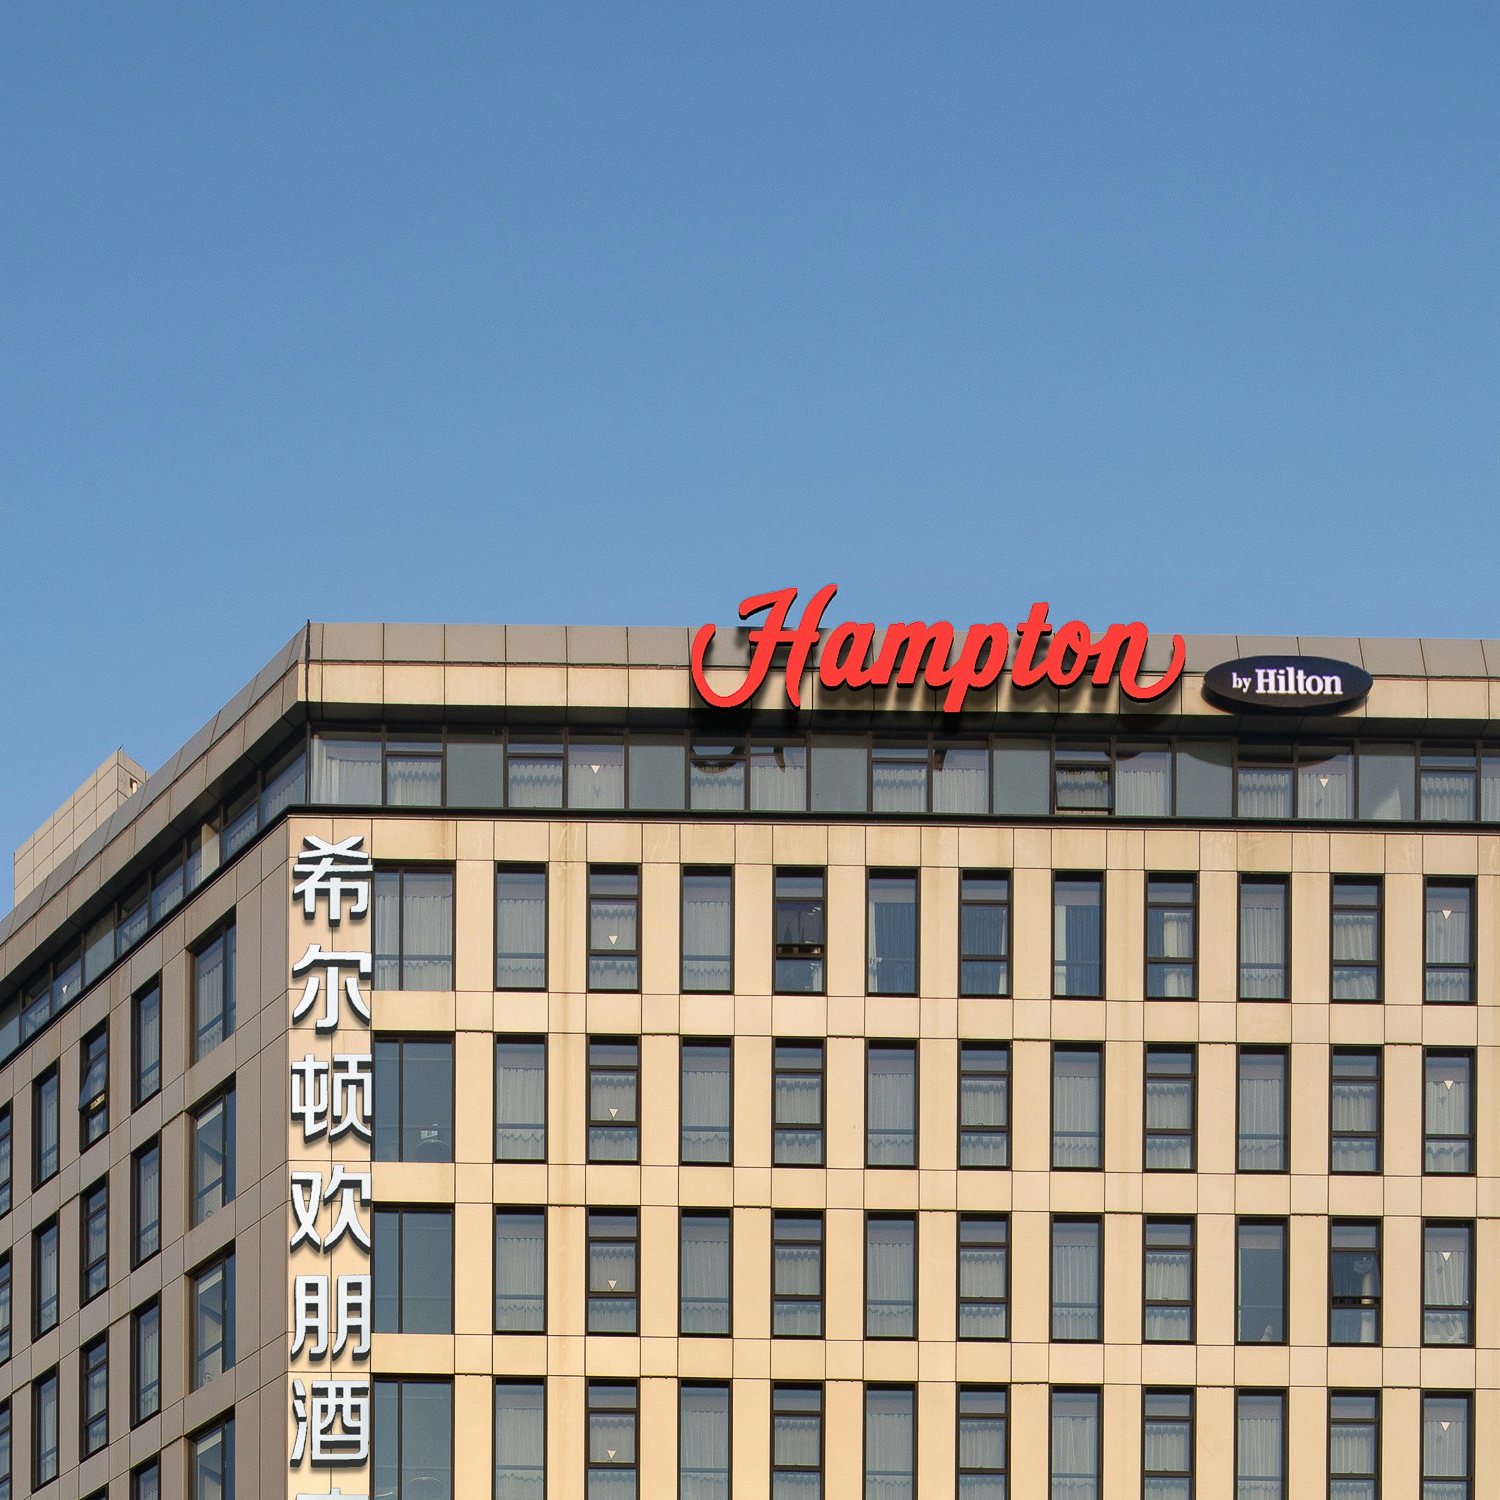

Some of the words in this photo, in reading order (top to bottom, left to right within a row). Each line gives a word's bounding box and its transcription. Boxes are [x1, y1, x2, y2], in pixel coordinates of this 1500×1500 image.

[690, 583, 1186, 713] Hampton
[1232, 672, 1252, 693] by
[1255, 666, 1343, 695] Hilton
